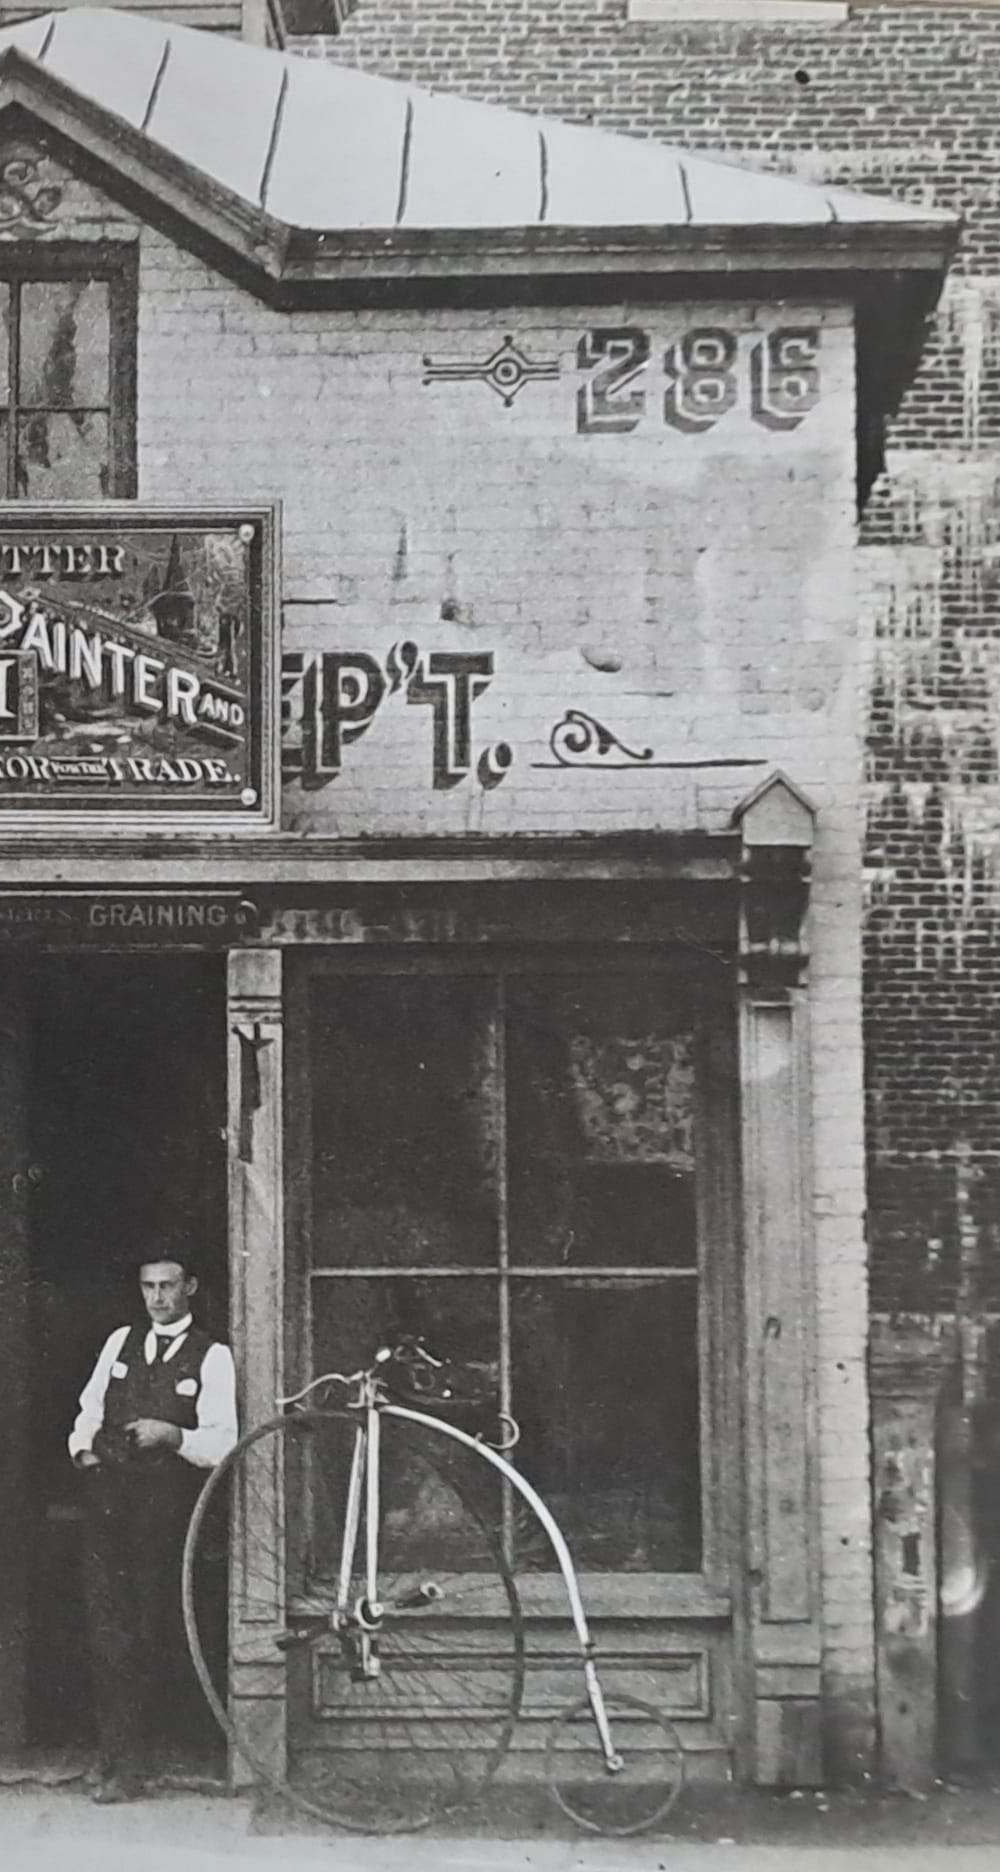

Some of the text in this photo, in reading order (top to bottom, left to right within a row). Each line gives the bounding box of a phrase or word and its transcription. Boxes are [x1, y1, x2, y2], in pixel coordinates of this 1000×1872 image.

[576, 327, 821, 434] 286
[199, 694, 245, 726] AND
[89, 903, 228, 927] GRAINING
